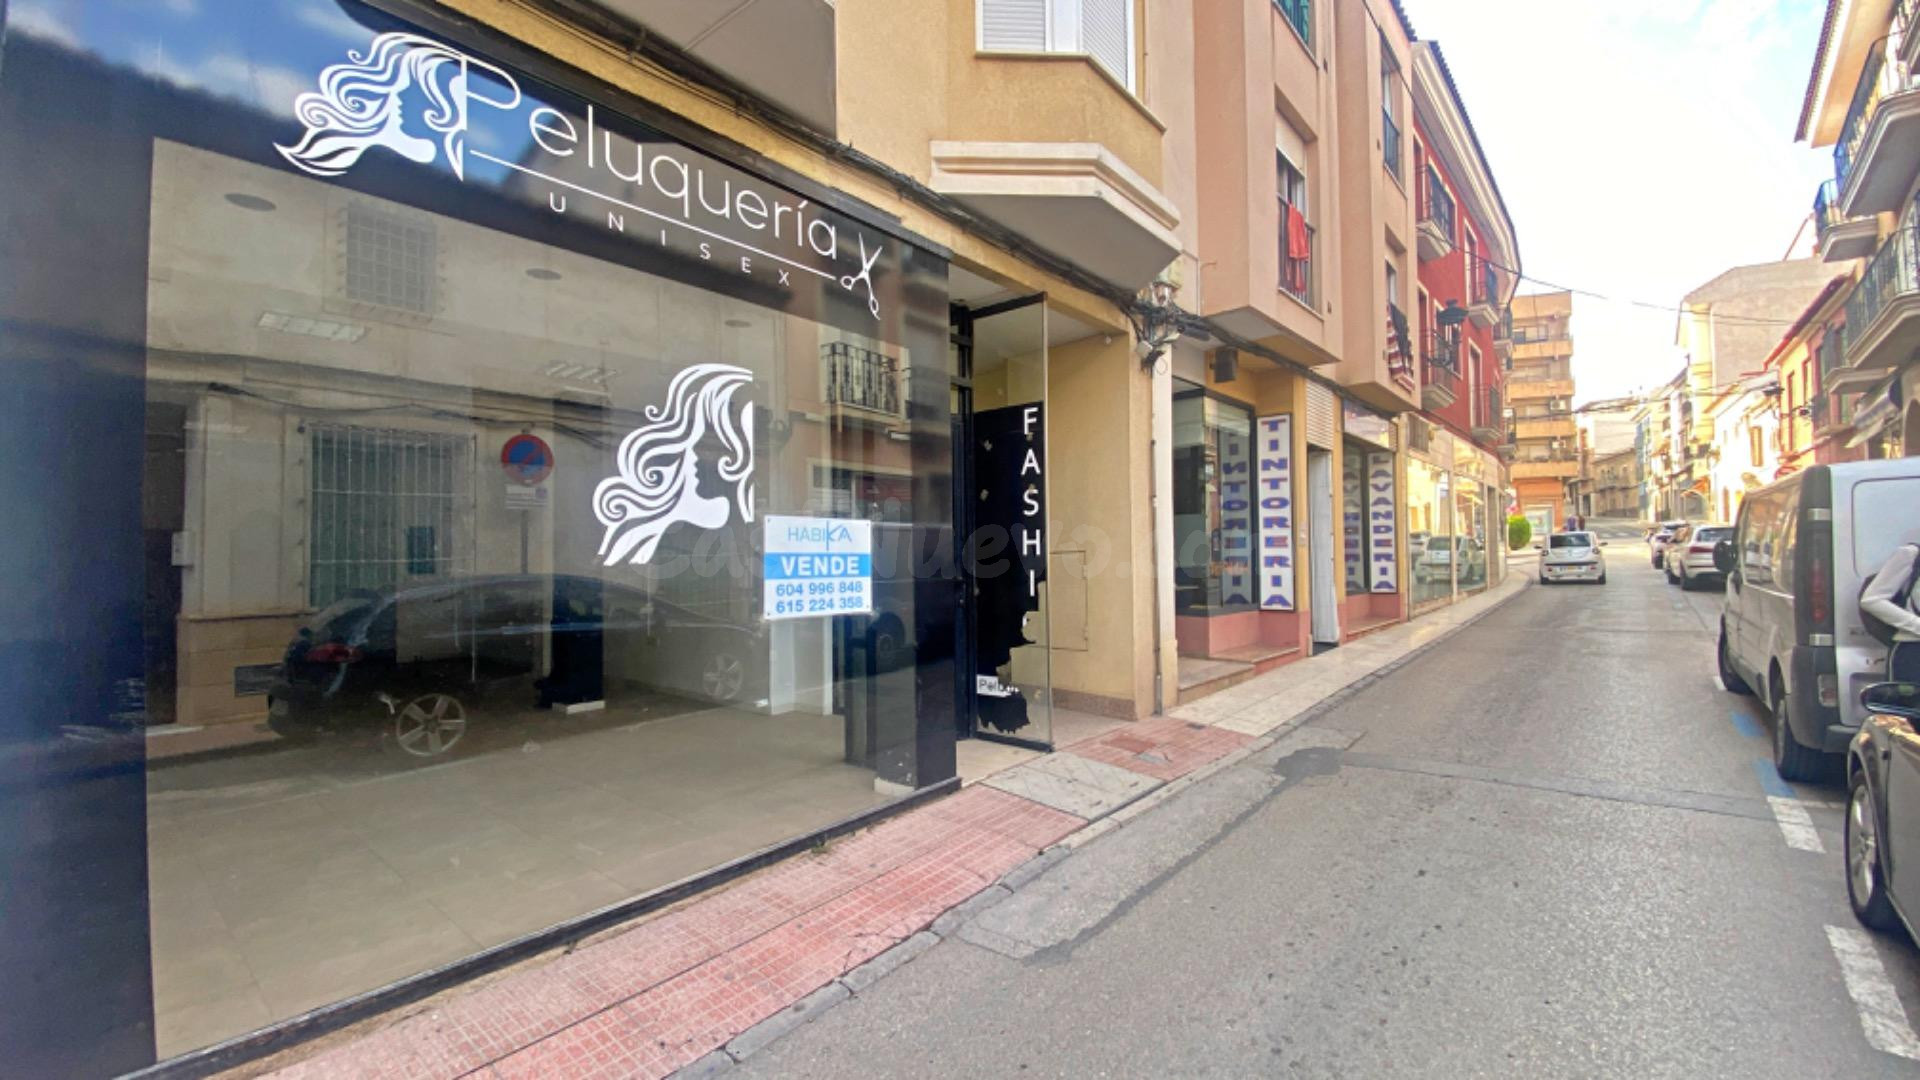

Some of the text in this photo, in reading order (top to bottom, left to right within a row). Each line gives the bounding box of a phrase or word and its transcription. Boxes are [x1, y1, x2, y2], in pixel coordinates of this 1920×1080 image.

[461, 55, 837, 260] Peluquería
[549, 191, 790, 287] UNISEX
[788, 520, 853, 551] HABIKA
[1020, 407, 1041, 628] FASHI
[1261, 418, 1292, 607] TINTORERIA
[1371, 456, 1395, 589] LAVANDERIA
[776, 581, 863, 597] 604 996 848
[776, 596, 863, 613] 615 224 358
[781, 556, 860, 577] VENDE
